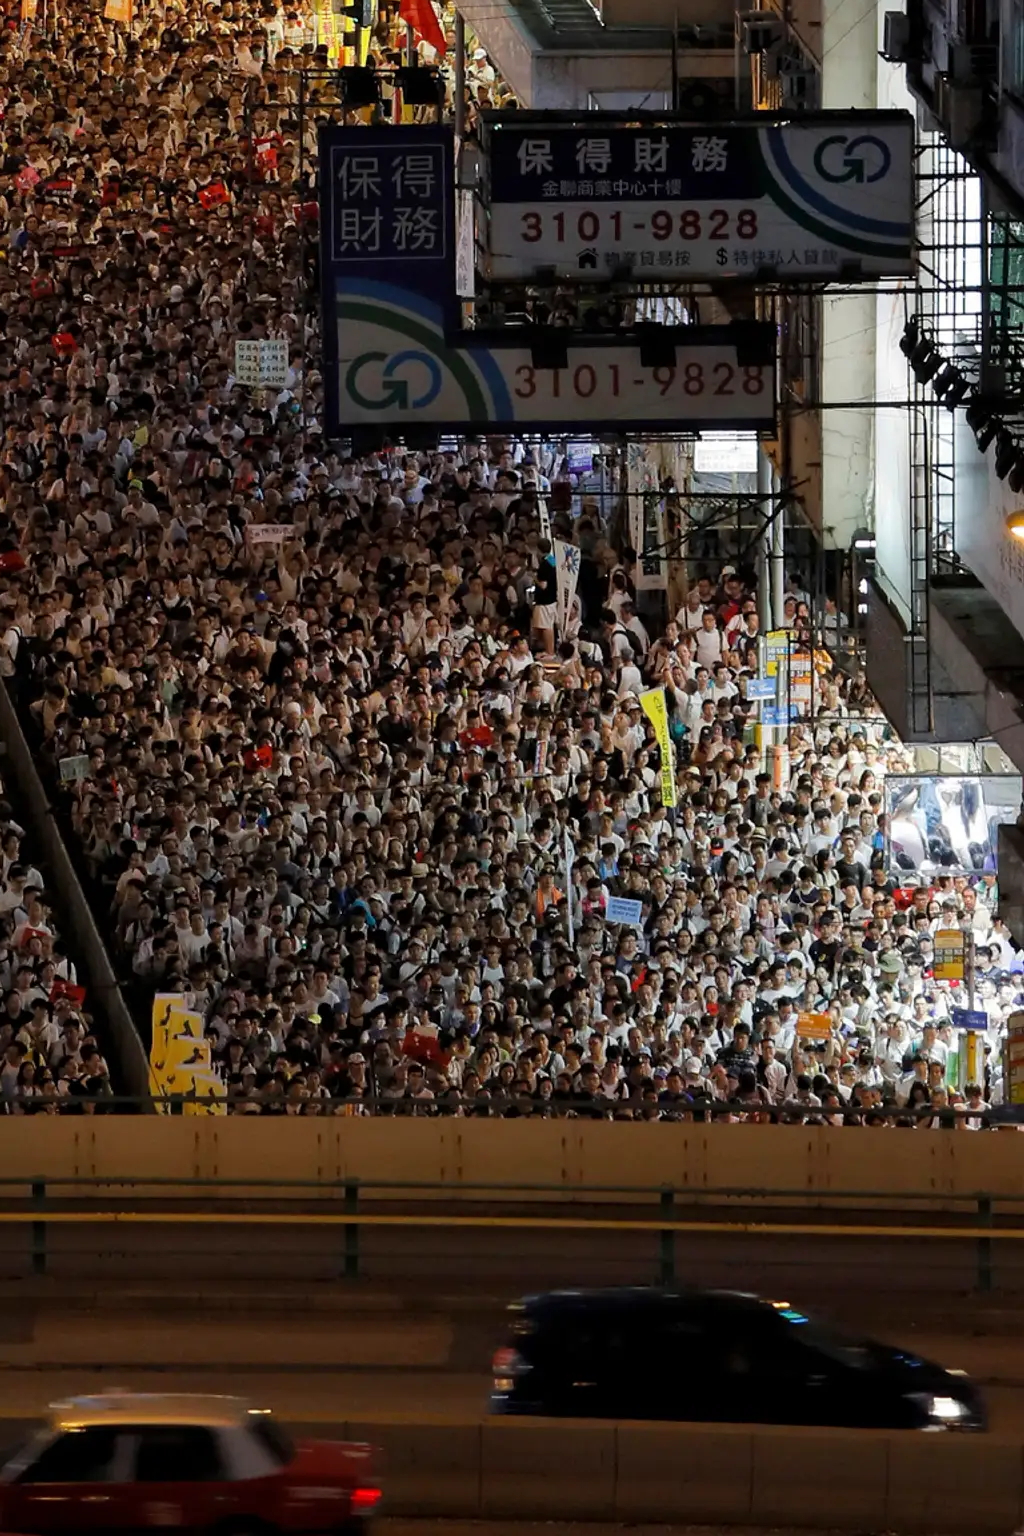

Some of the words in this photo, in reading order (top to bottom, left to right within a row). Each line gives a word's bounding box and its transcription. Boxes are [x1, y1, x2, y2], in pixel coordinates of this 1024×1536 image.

[516, 135, 729, 176] 保得財務
[337, 154, 436, 201] 保得
[339, 206, 439, 252] 財務
[520, 209, 759, 243] 3101-9828
[514, 364, 767, 399] 3101-9828
